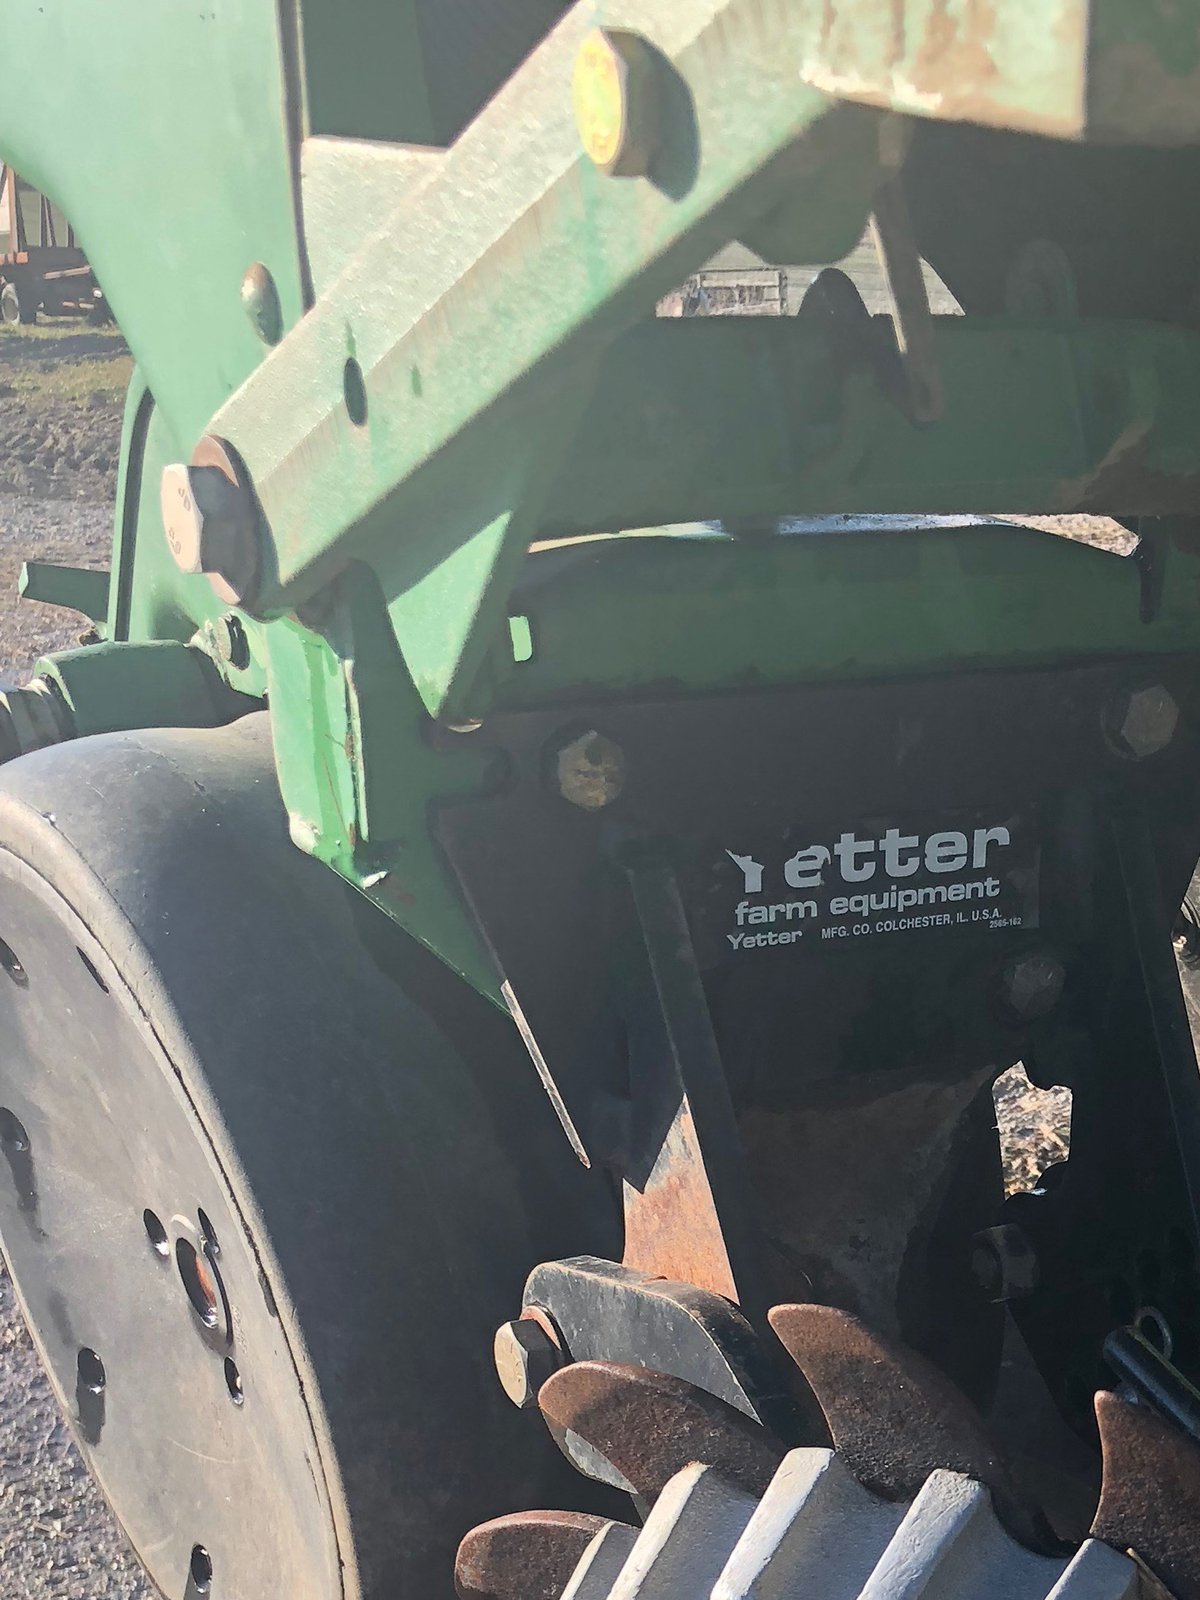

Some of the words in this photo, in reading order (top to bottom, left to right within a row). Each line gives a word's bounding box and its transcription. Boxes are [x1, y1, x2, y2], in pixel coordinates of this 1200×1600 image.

[725, 826, 1010, 893] Yetter
[735, 901, 818, 926] farm
[829, 876, 1001, 915] equipment
[726, 930, 803, 950] Yetter
[821, 925, 850, 940] MFG.
[852, 922, 873, 936] CO.
[875, 912, 954, 934] COLCHESTER,
[971, 907, 1002, 921] U.S.A.
